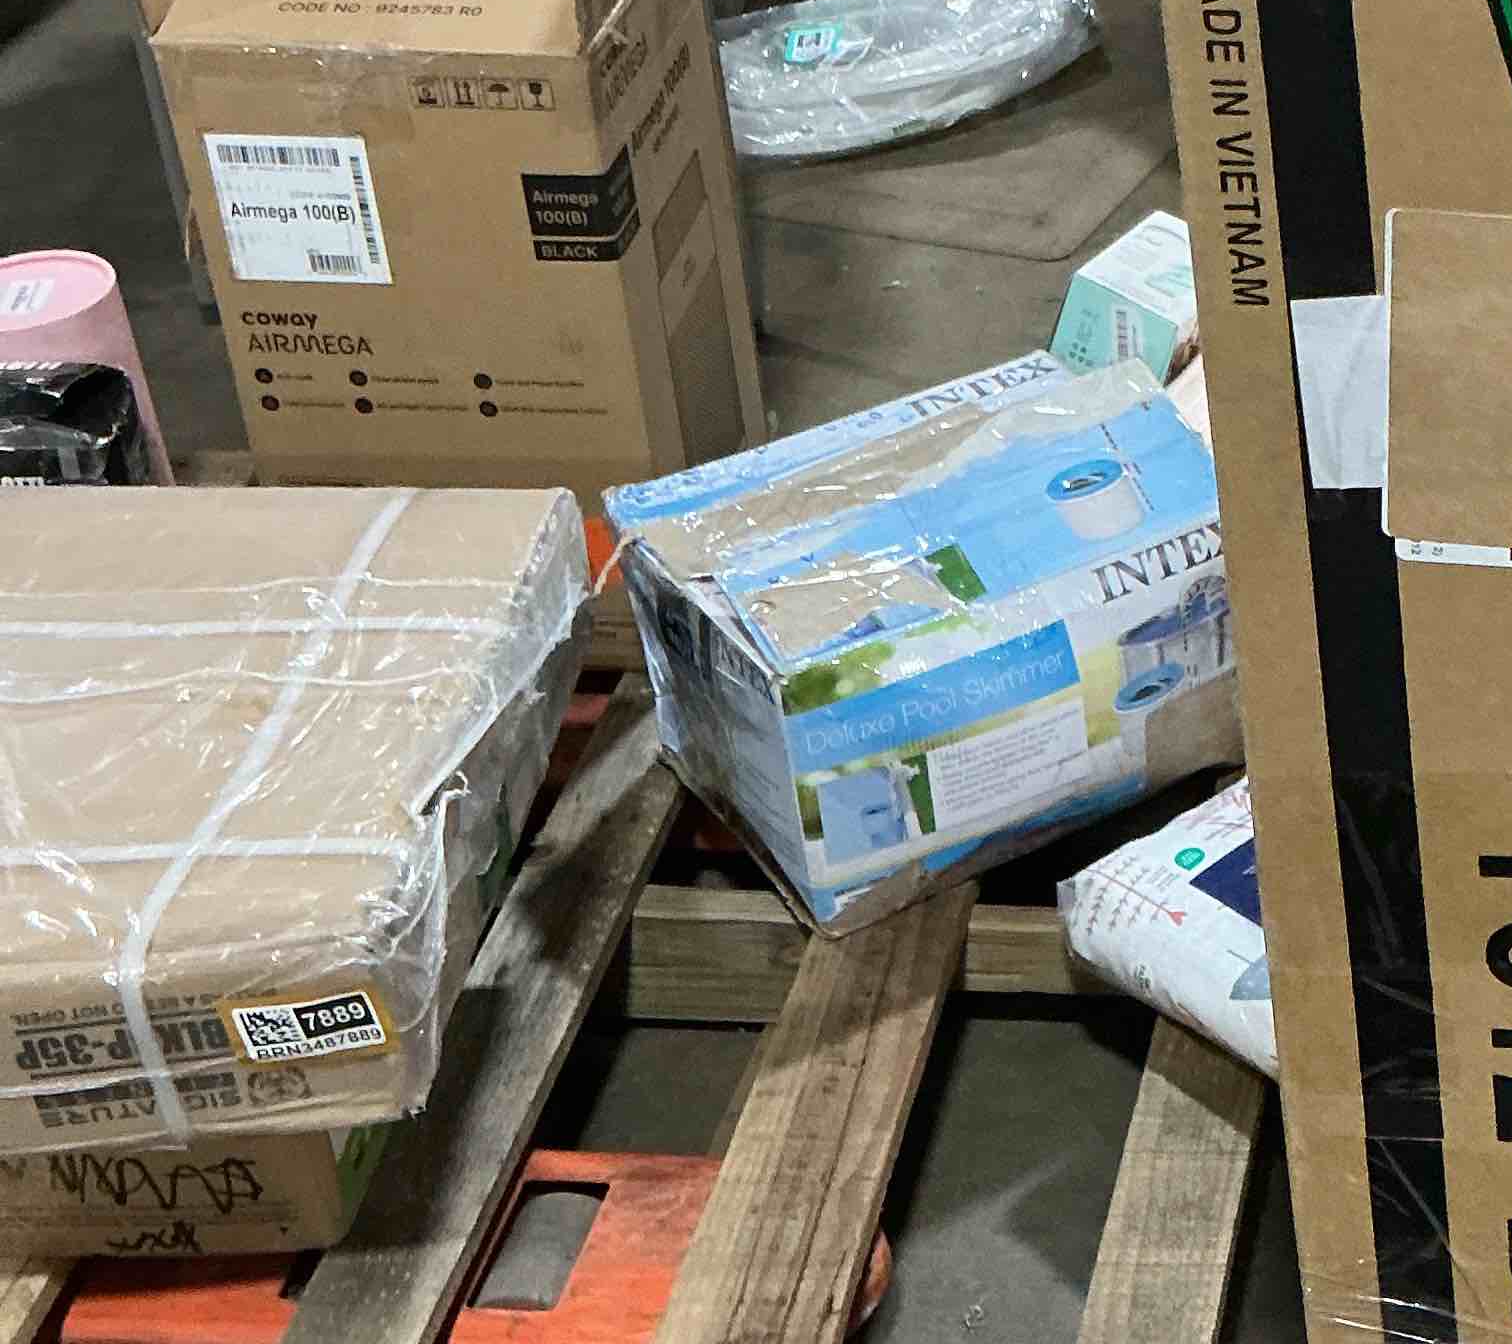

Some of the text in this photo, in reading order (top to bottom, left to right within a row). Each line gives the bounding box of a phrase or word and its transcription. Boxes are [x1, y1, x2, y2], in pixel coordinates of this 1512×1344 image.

[277, 0, 329, 14] CODE
[333, 2, 362, 15] NO
[1208, 78, 1251, 117] IN
[531, 189, 600, 207] Airmega
[230, 201, 357, 225] Airmega 100(B)
[535, 210, 589, 227] 100(B)
[1215, 130, 1270, 307] VIETNAM
[540, 244, 598, 258] BLACK
[241, 310, 319, 331] coway
[247, 332, 375, 356] AIRMEGA
[908, 356, 1058, 419] INTEX
[806, 651, 1067, 755] Deluxe Pool Skimmer
[300, 1002, 366, 1032] 7889
